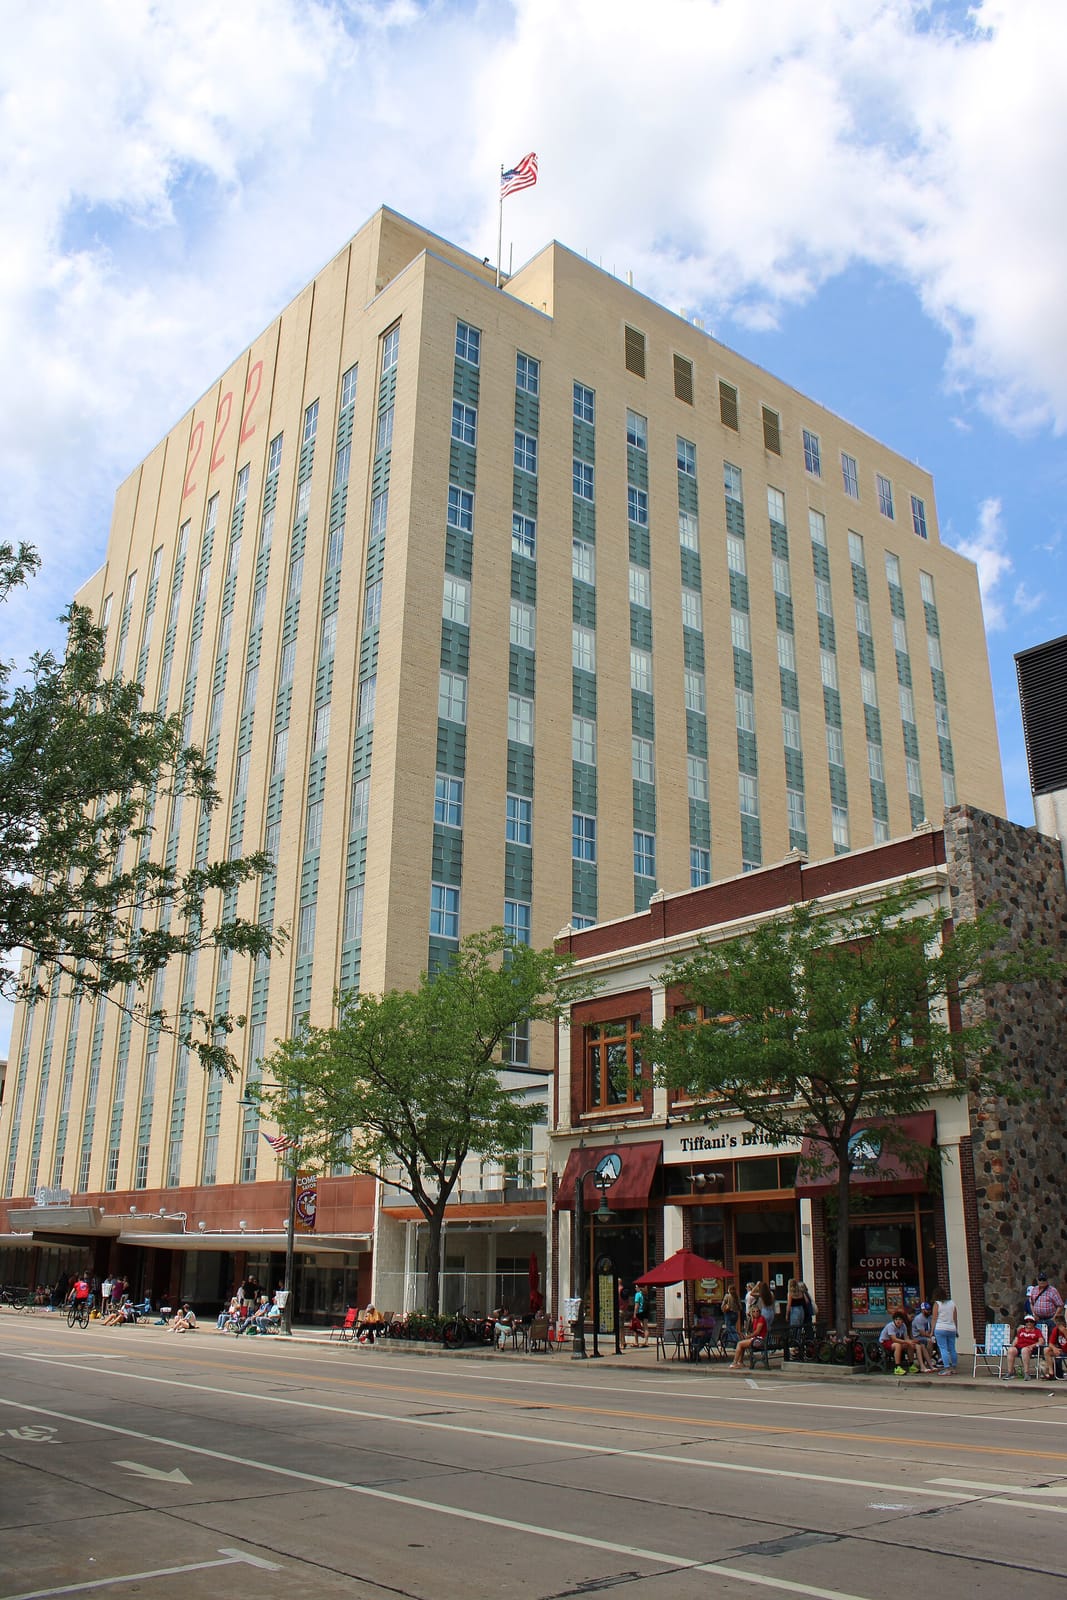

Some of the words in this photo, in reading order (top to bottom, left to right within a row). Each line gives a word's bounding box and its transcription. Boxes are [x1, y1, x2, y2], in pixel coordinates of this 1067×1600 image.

[183, 360, 263, 500] 222
[680, 1133, 737, 1152] Tiffani's
[741, 1127, 790, 1146] Brid
[297, 1175, 317, 1186] COME
[859, 1258, 906, 1268] COPPER
[867, 1270, 898, 1280] ROCK
